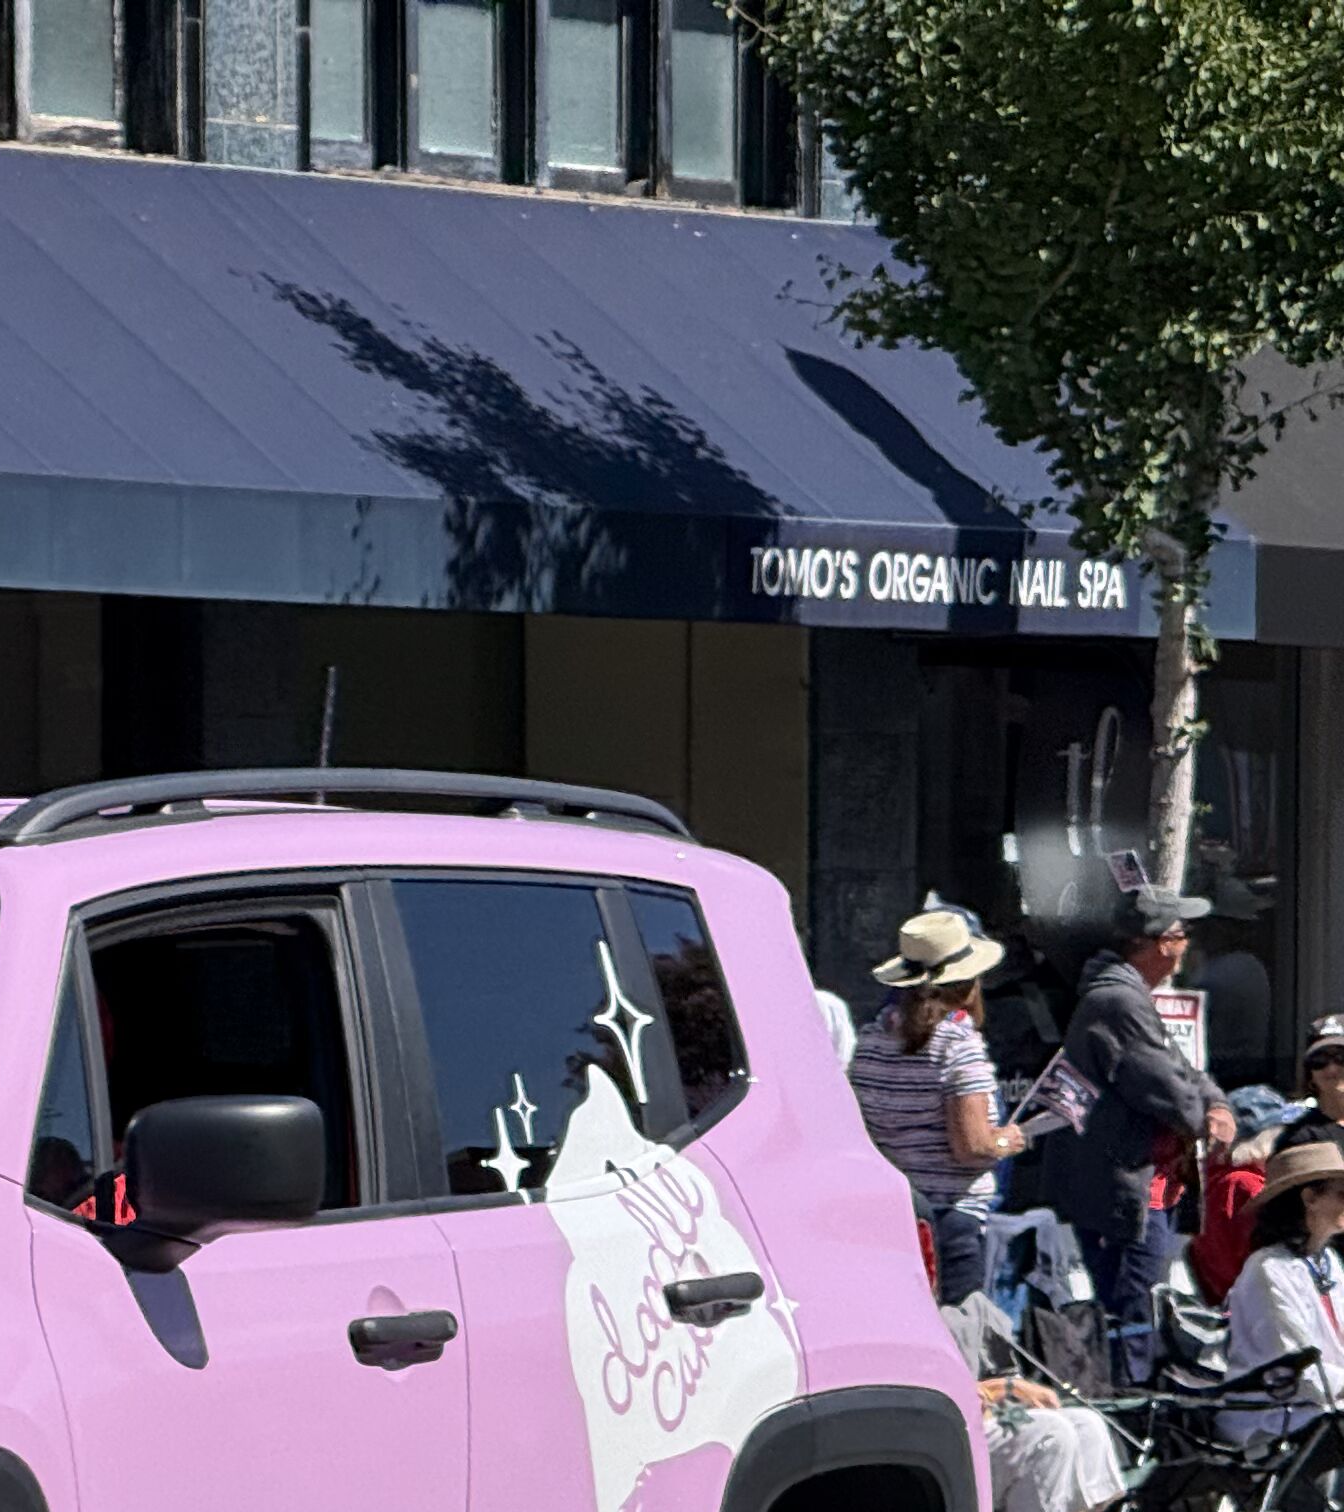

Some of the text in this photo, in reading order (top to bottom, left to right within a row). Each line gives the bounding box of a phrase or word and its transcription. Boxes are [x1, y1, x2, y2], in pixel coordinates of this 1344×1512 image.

[750, 547, 1127, 610] TOMO'S ORGANIC NAIL SPA
